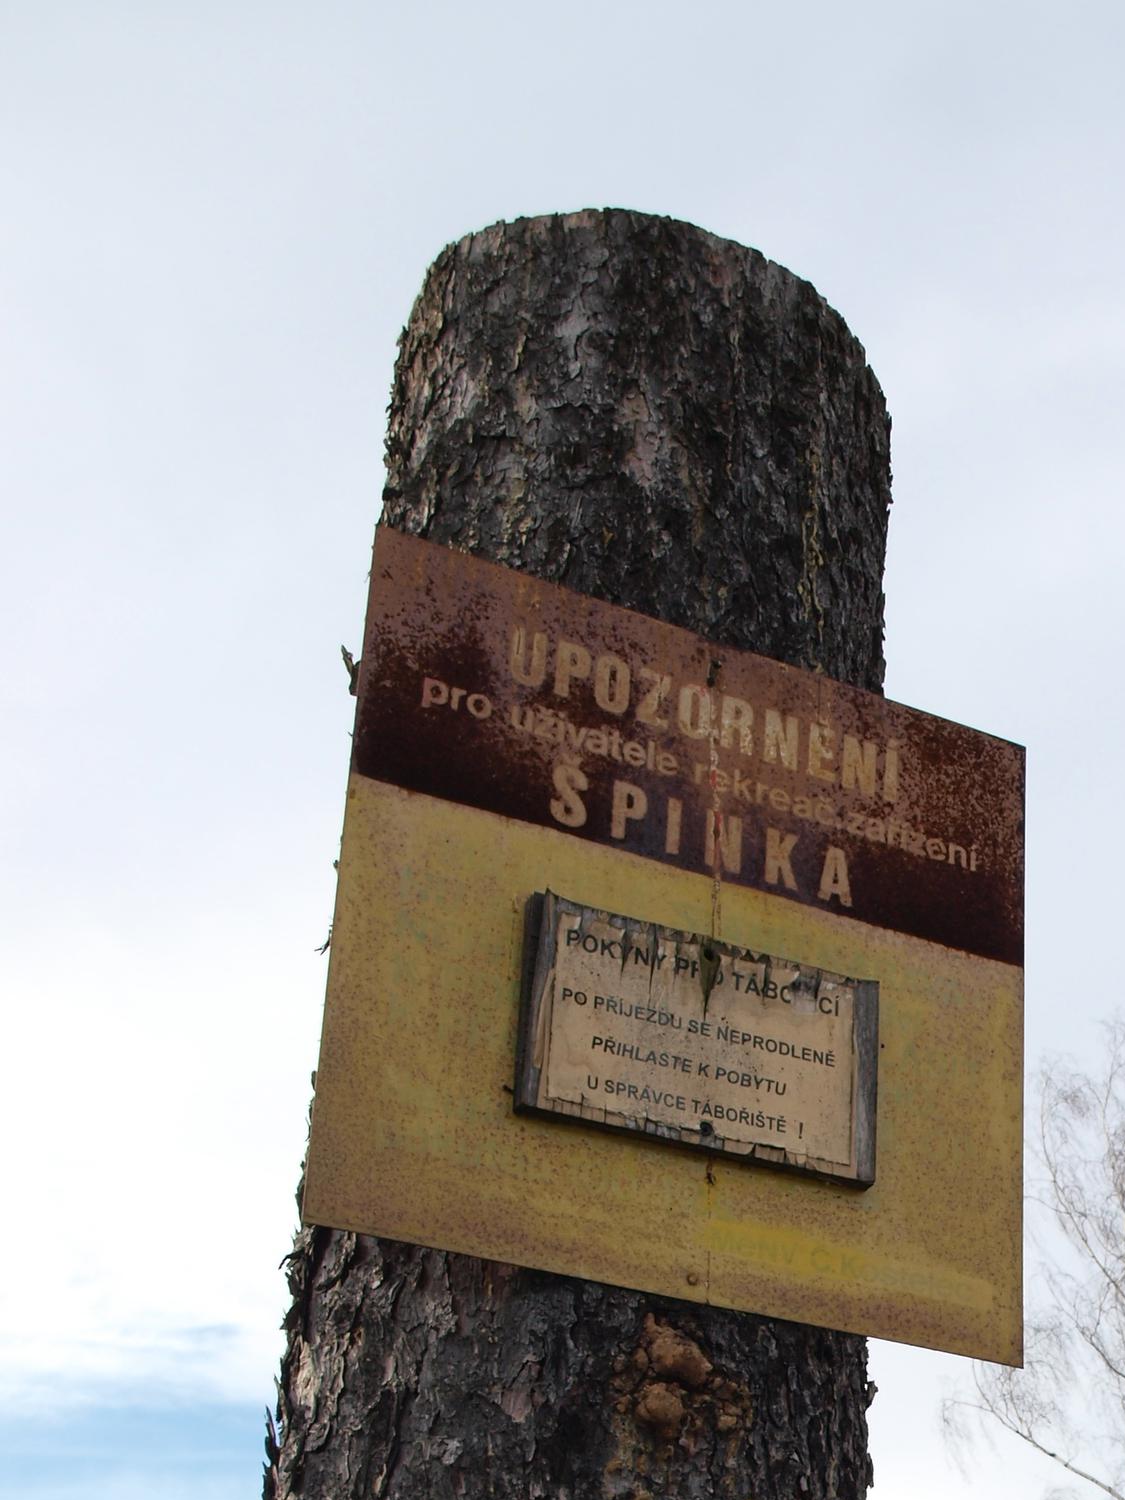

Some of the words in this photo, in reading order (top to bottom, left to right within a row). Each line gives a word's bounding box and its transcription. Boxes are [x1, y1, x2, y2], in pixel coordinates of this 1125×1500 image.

[421, 677, 493, 719] pro
[550, 750, 853, 908] ŠPINKA
[566, 929, 667, 970] POKYNY
[562, 987, 588, 1006] PO
[593, 994, 682, 1030] PŘÍJEZDU
[688, 1019, 711, 1038] SE
[717, 1025, 836, 1068] NEPRODLENĚ
[698, 1062, 710, 1078] K
[715, 1066, 787, 1096] POBYTU
[587, 1075, 598, 1090] U
[604, 1079, 686, 1111] SPRÁVCE
[691, 1098, 787, 1134] TÁBOŘIŠTĚ
[798, 1122, 804, 1139] !
